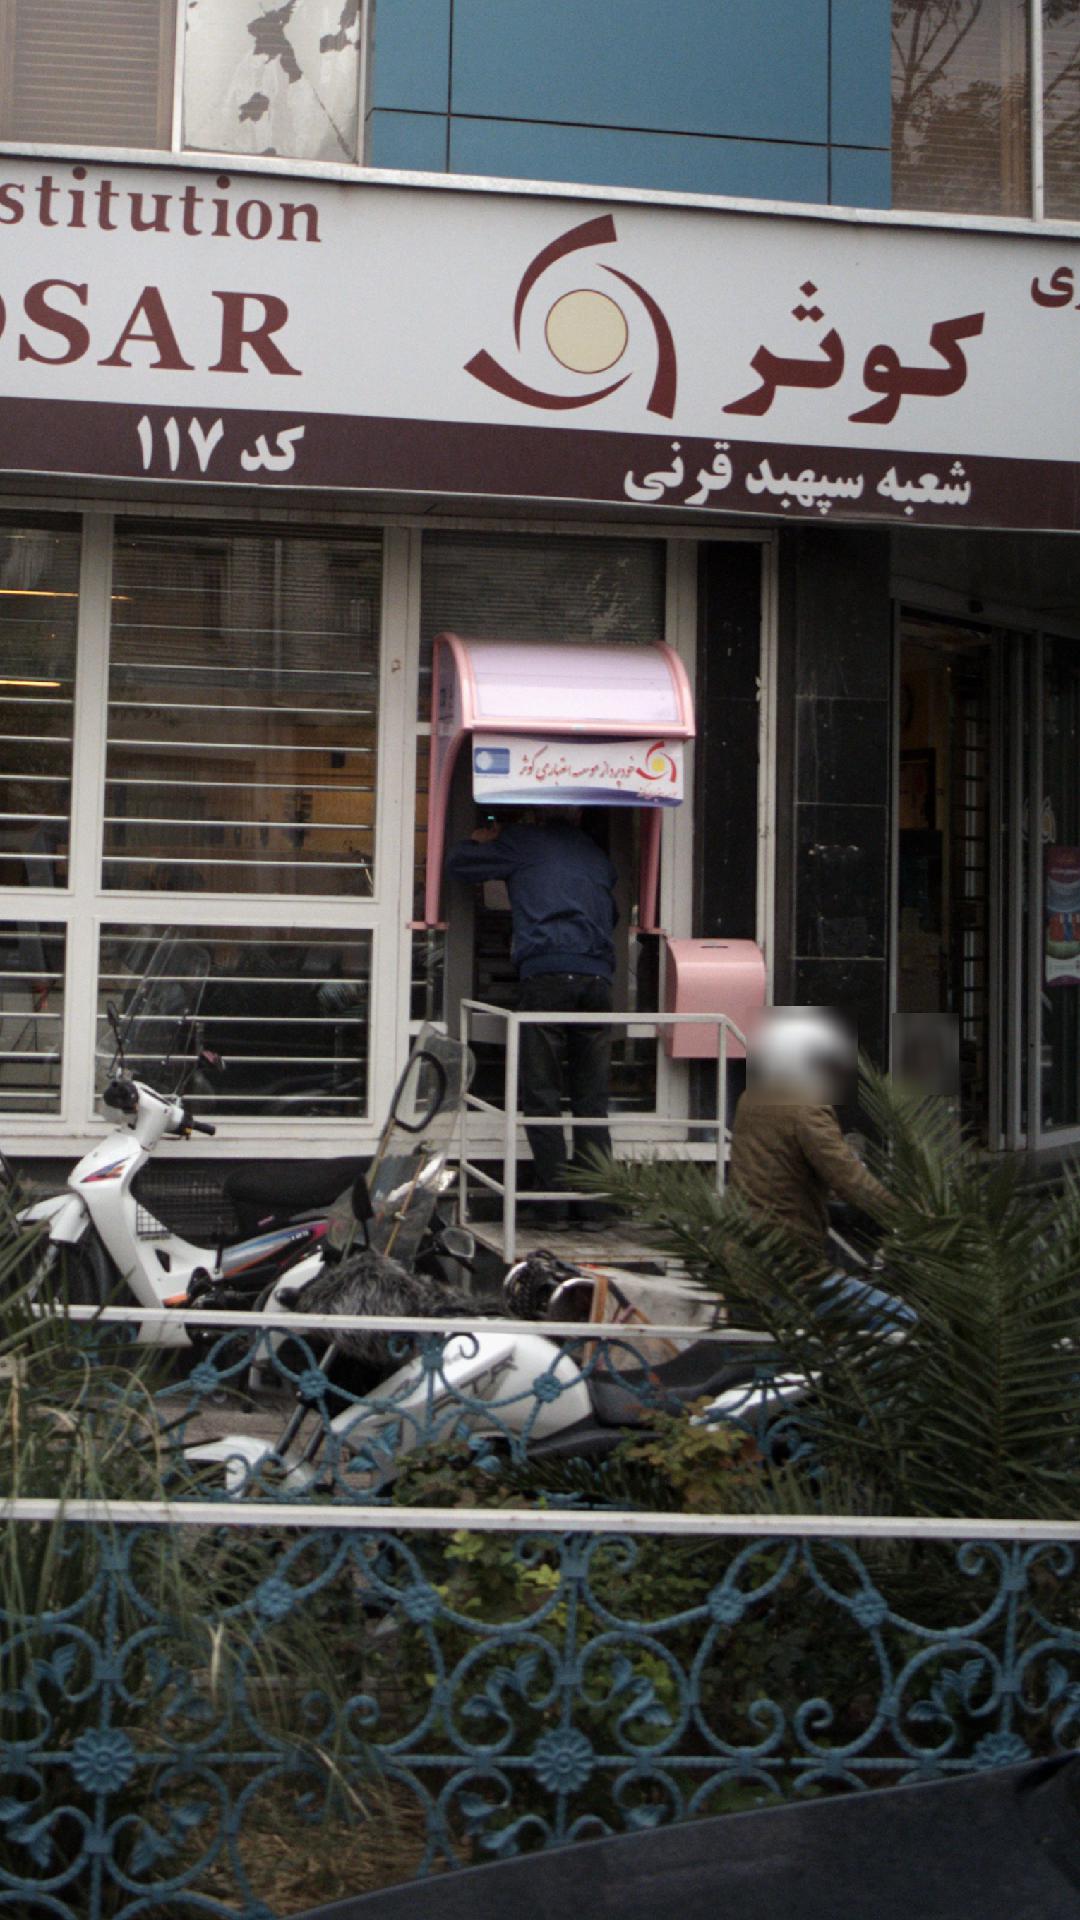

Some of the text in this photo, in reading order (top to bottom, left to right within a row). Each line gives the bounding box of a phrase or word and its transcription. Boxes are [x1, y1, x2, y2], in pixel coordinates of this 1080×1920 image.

[0, 166, 321, 243] stitution
[1031, 266, 1080, 310] ی
[0, 279, 304, 376] SAR
[722, 280, 985, 425] کوثر
[137, 415, 305, 473] کد ۱۱۷
[624, 441, 972, 516] شعبه سپهبد قرنی
[519, 744, 549, 776] کوثر
